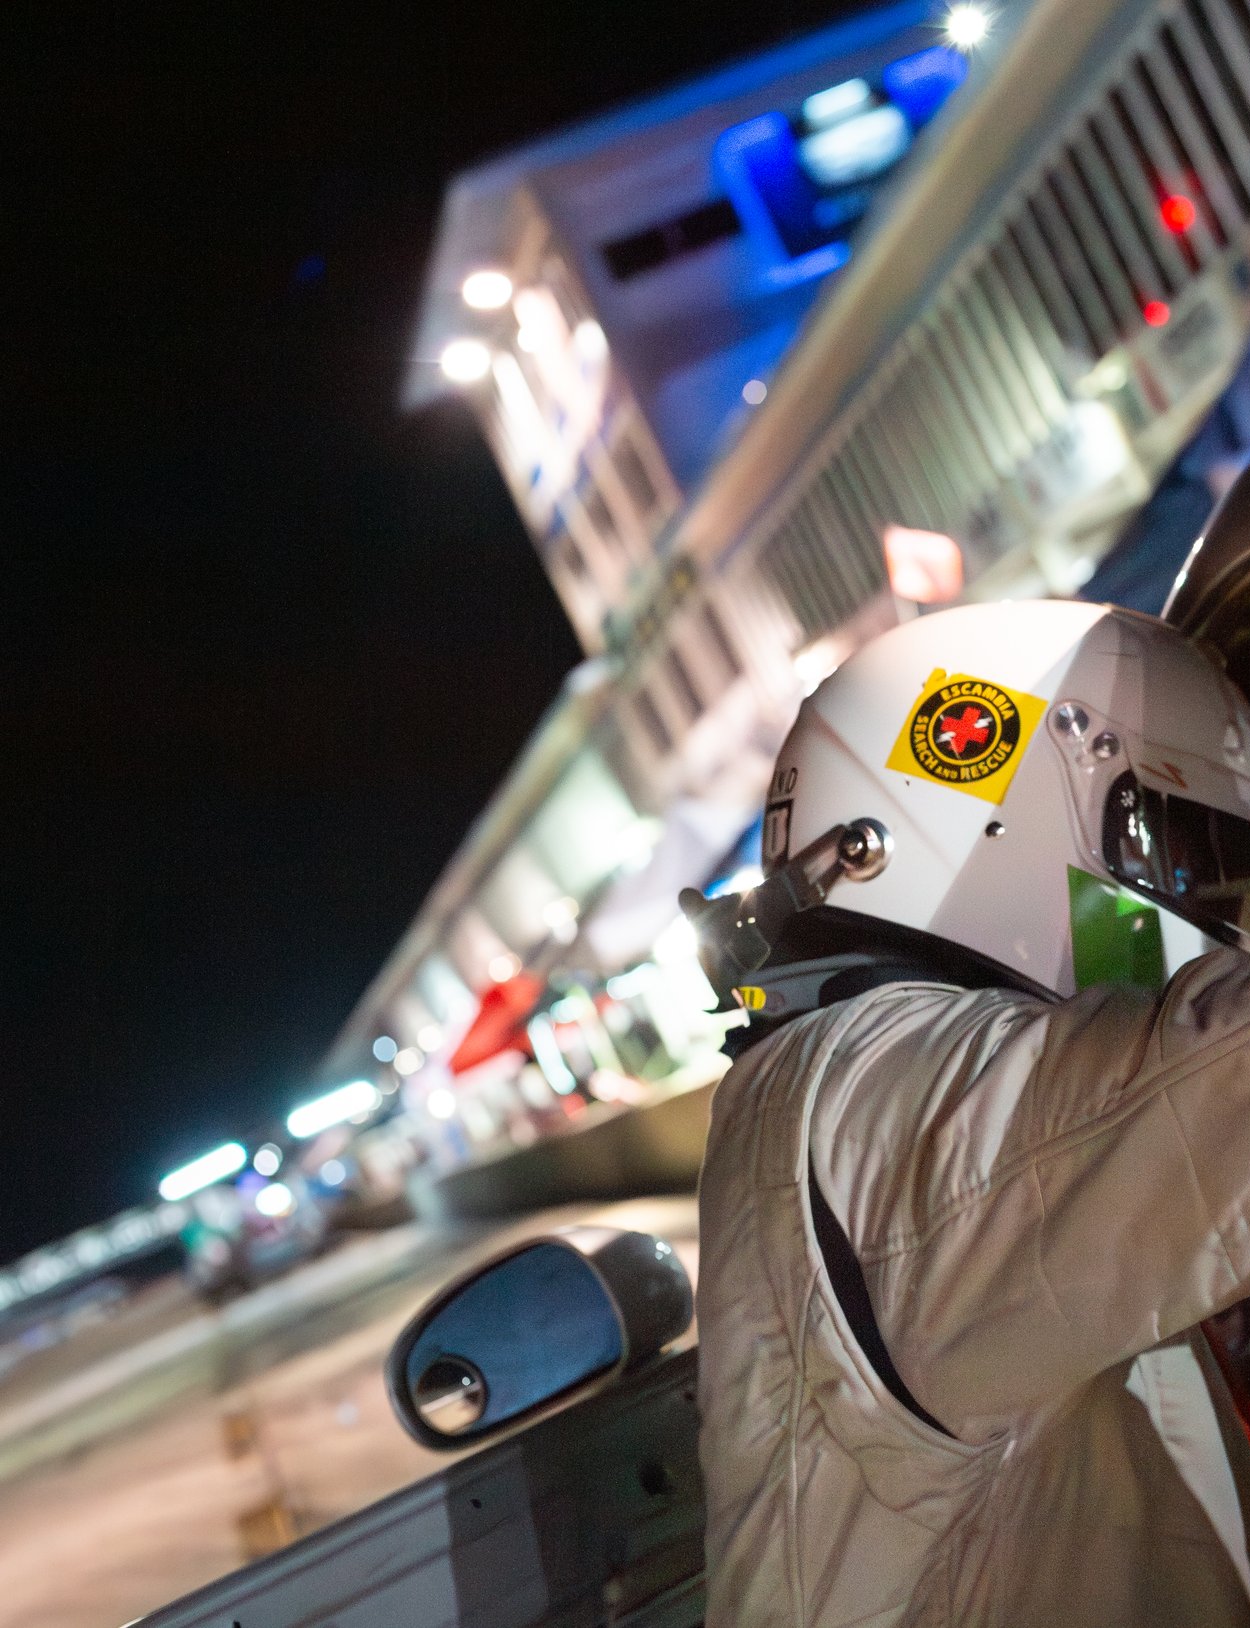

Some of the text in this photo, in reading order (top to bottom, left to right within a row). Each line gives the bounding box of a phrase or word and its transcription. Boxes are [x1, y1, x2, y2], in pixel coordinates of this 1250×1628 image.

[940, 682, 1015, 720] ESCAMBIA
[913, 715, 938, 770] SEARCH
[960, 740, 1013, 780] RESCUE
